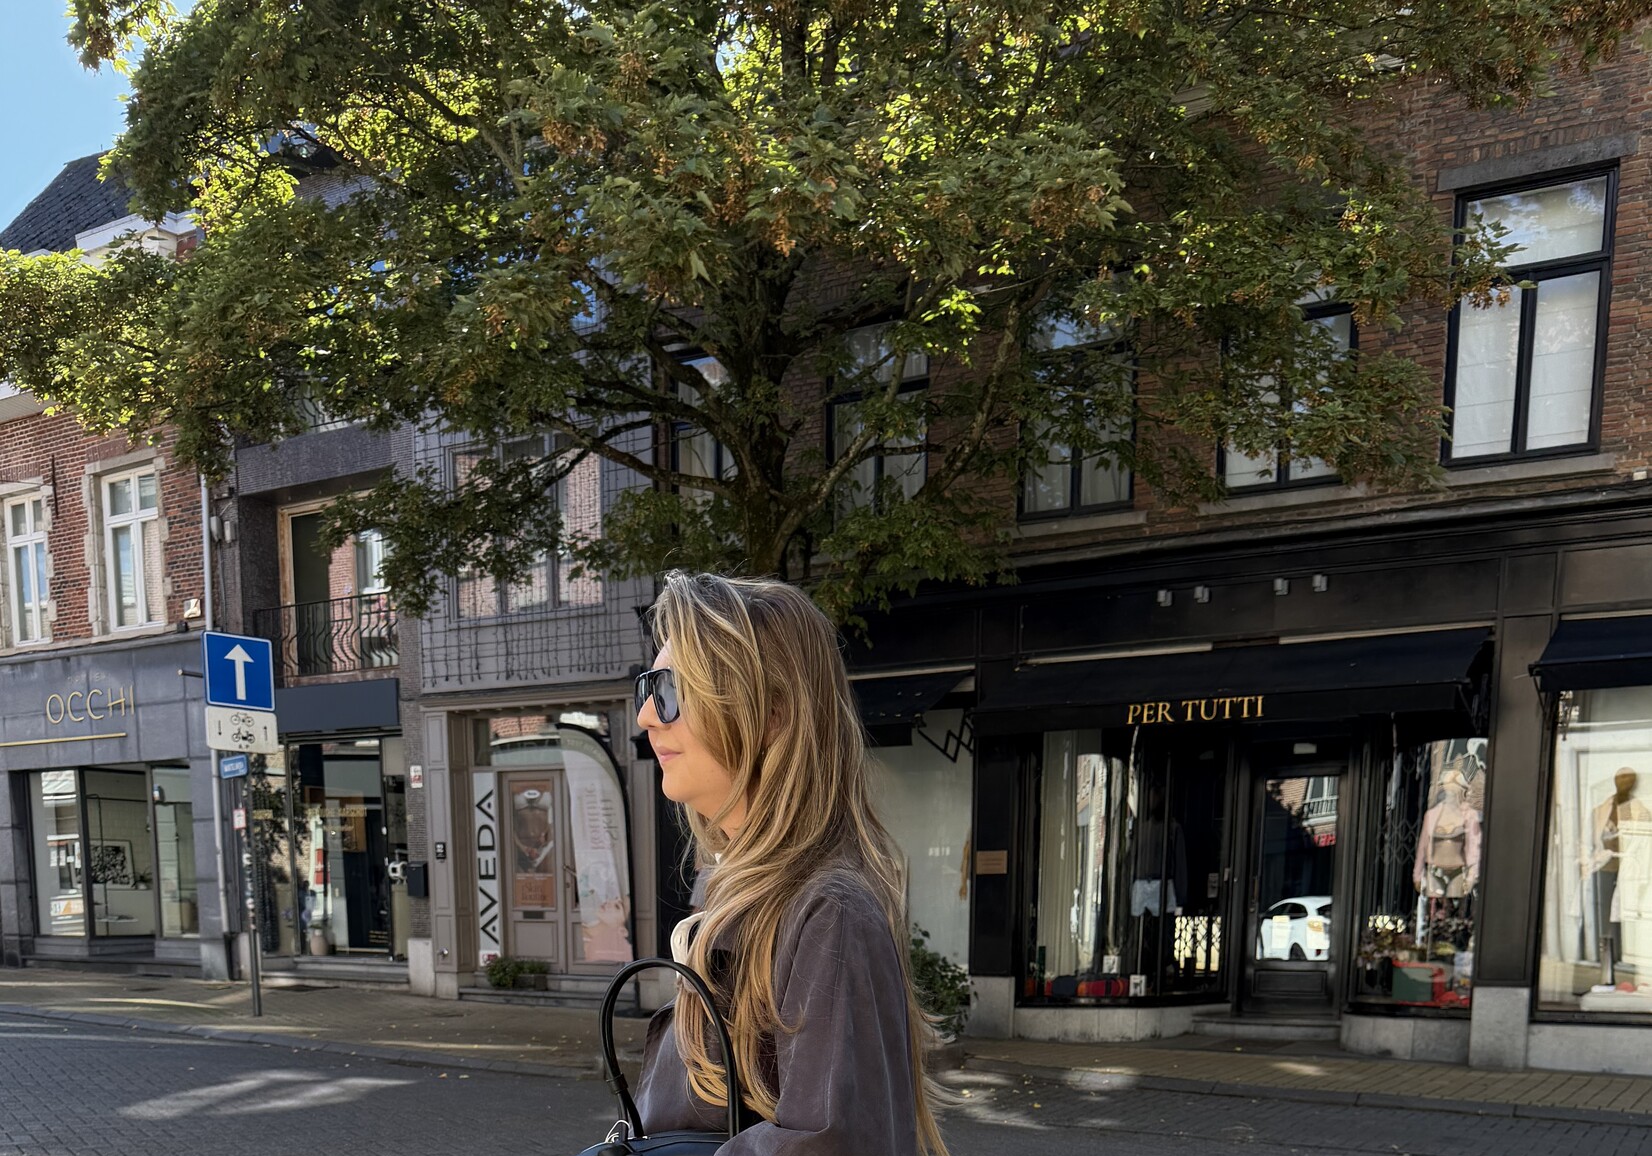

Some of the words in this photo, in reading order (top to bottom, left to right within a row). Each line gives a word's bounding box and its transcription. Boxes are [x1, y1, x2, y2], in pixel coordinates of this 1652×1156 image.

[46, 685, 135, 724] OCCHI
[1126, 701, 1175, 725] PER
[1181, 695, 1264, 722] TUTTI
[475, 789, 499, 945] AVEDA
